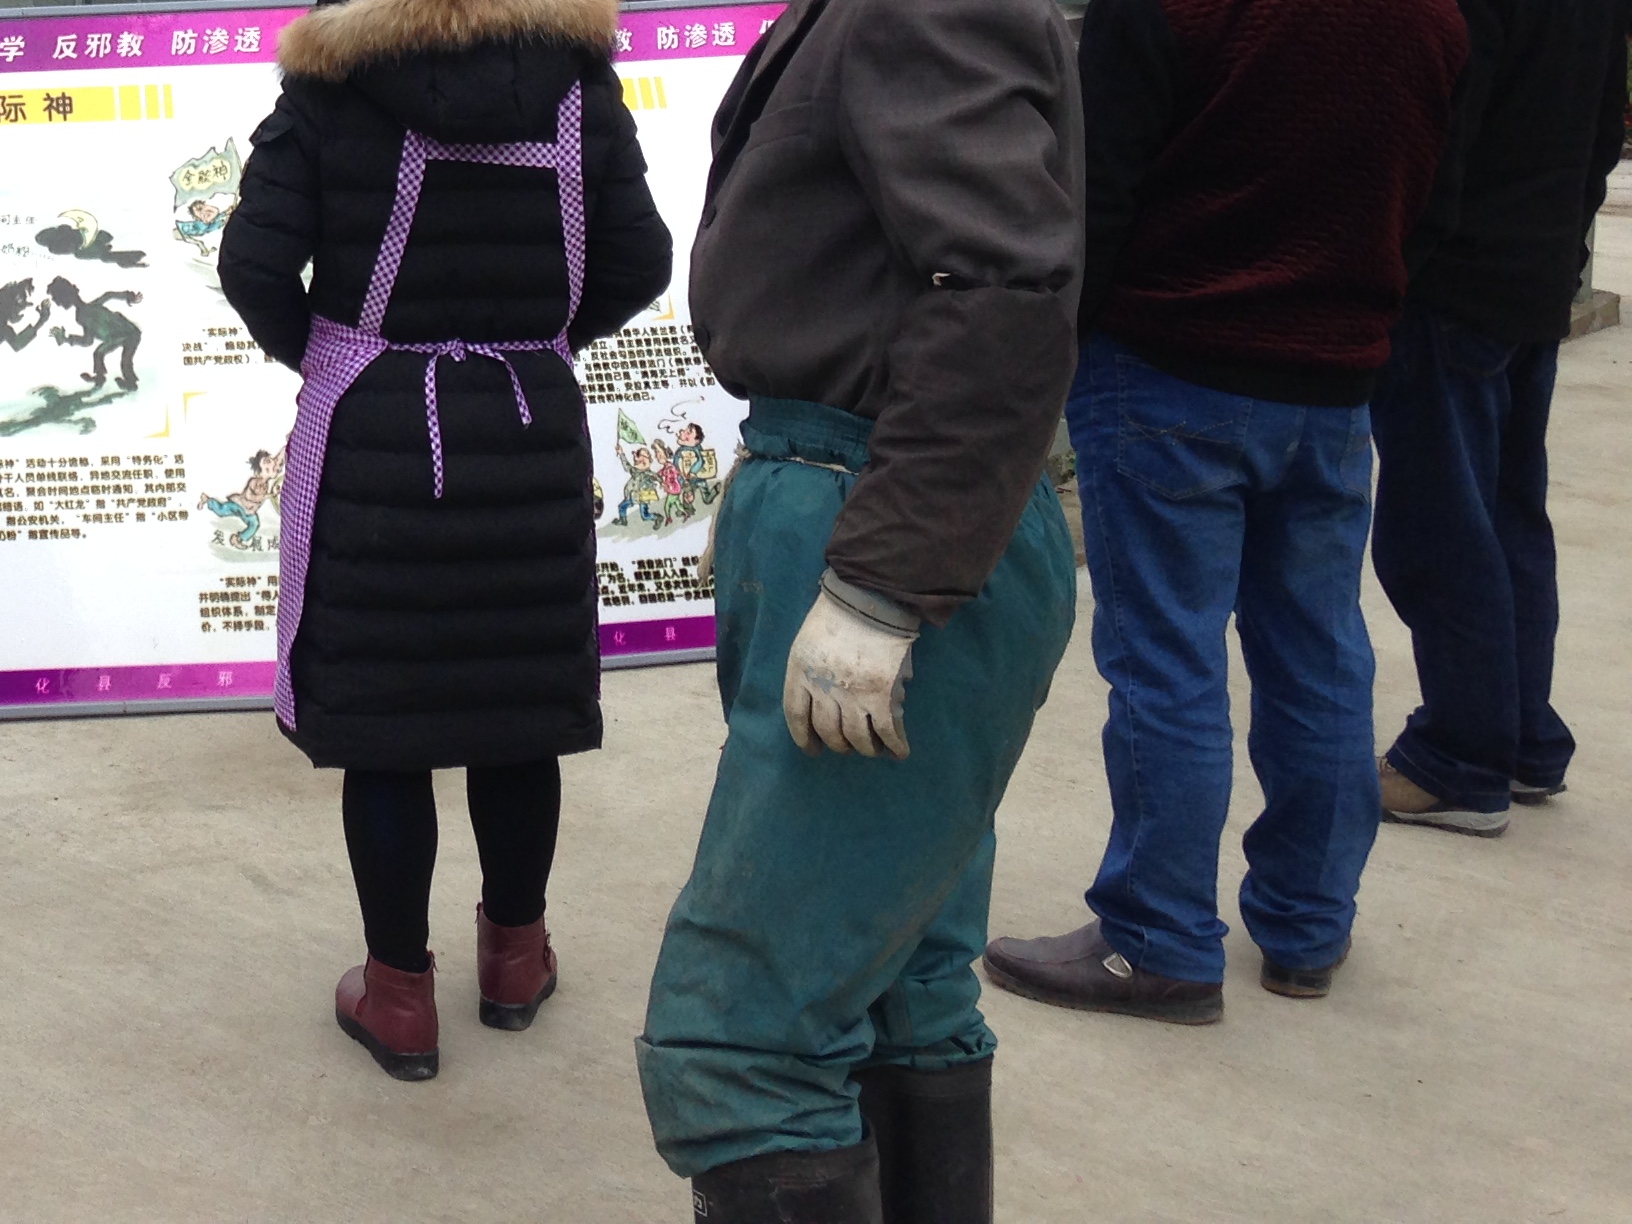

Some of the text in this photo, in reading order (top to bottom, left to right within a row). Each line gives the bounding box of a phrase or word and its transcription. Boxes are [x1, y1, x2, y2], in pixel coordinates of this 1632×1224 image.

[52, 31, 144, 61] 反邪教
[171, 26, 261, 56] 防渗透
[657, 21, 735, 50] 防渗透
